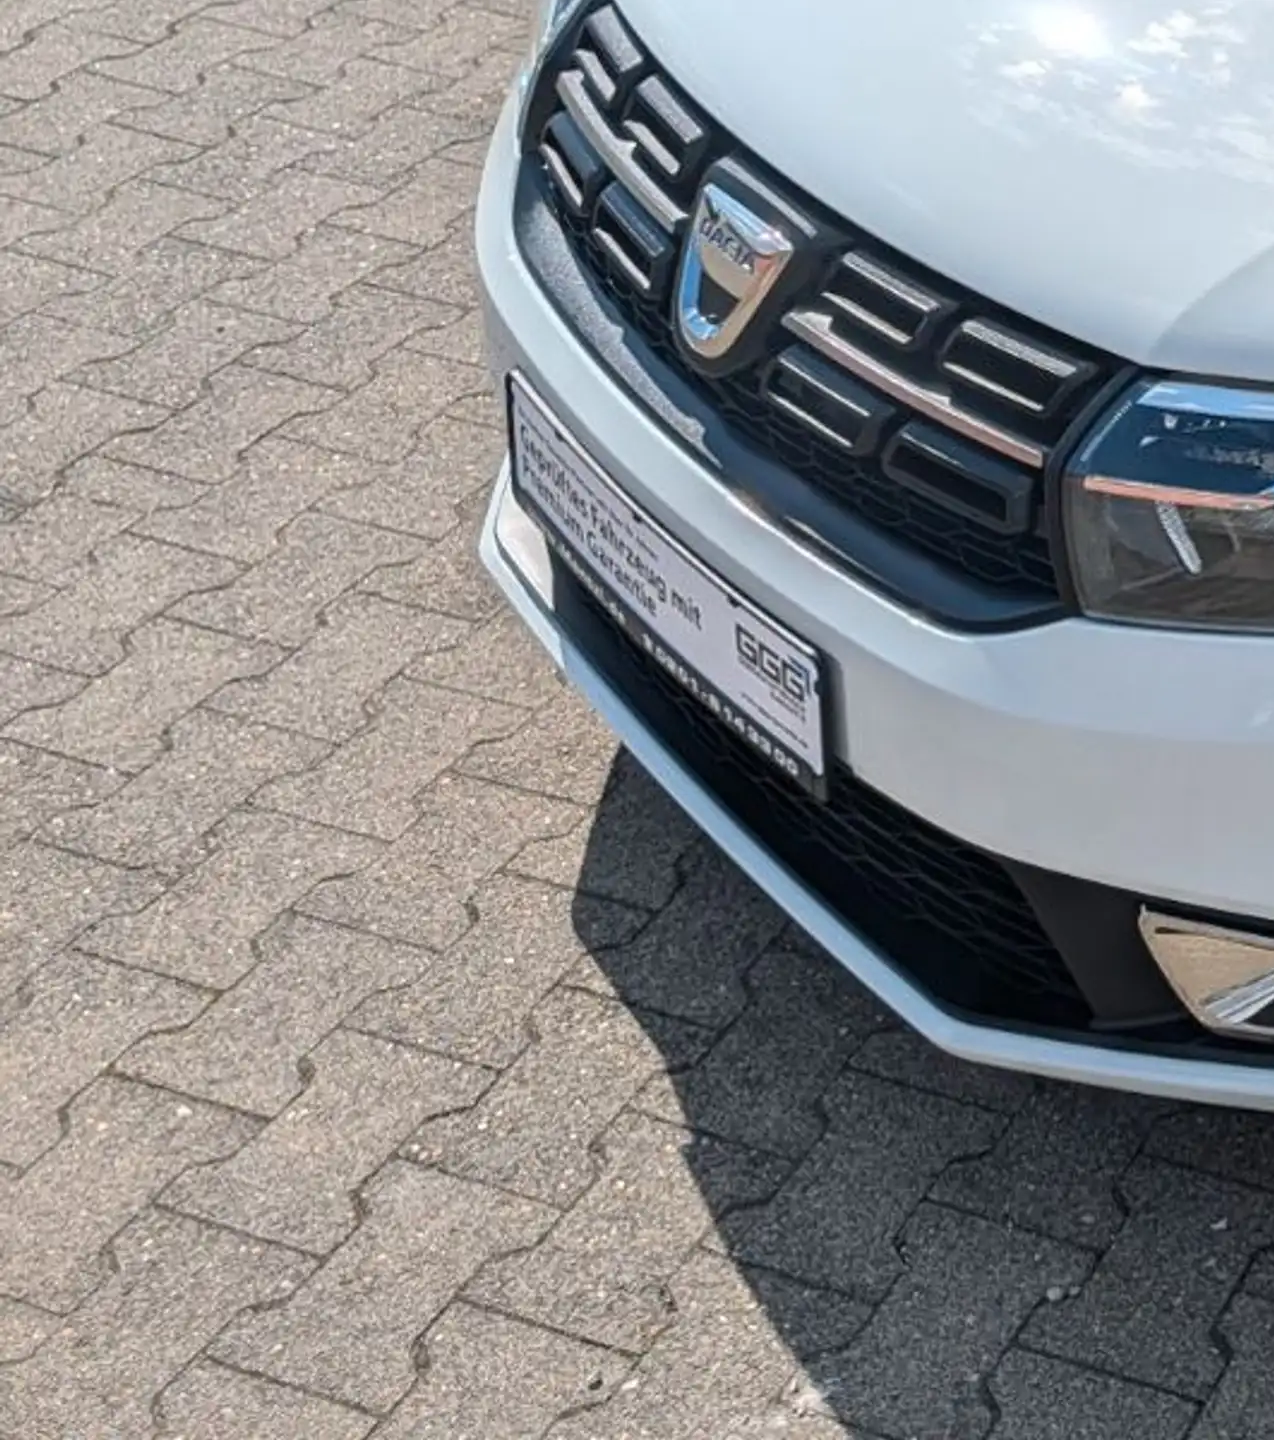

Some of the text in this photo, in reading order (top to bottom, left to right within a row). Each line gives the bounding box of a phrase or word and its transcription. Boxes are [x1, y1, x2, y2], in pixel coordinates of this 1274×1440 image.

[700, 218, 755, 275] DACIA
[519, 424, 590, 519] Geprüftes
[590, 503, 668, 603] Fahrzeug
[671, 588, 702, 631] mit
[522, 453, 586, 544] Premium
[585, 529, 658, 618] Garantie
[736, 623, 806, 702] GGG
